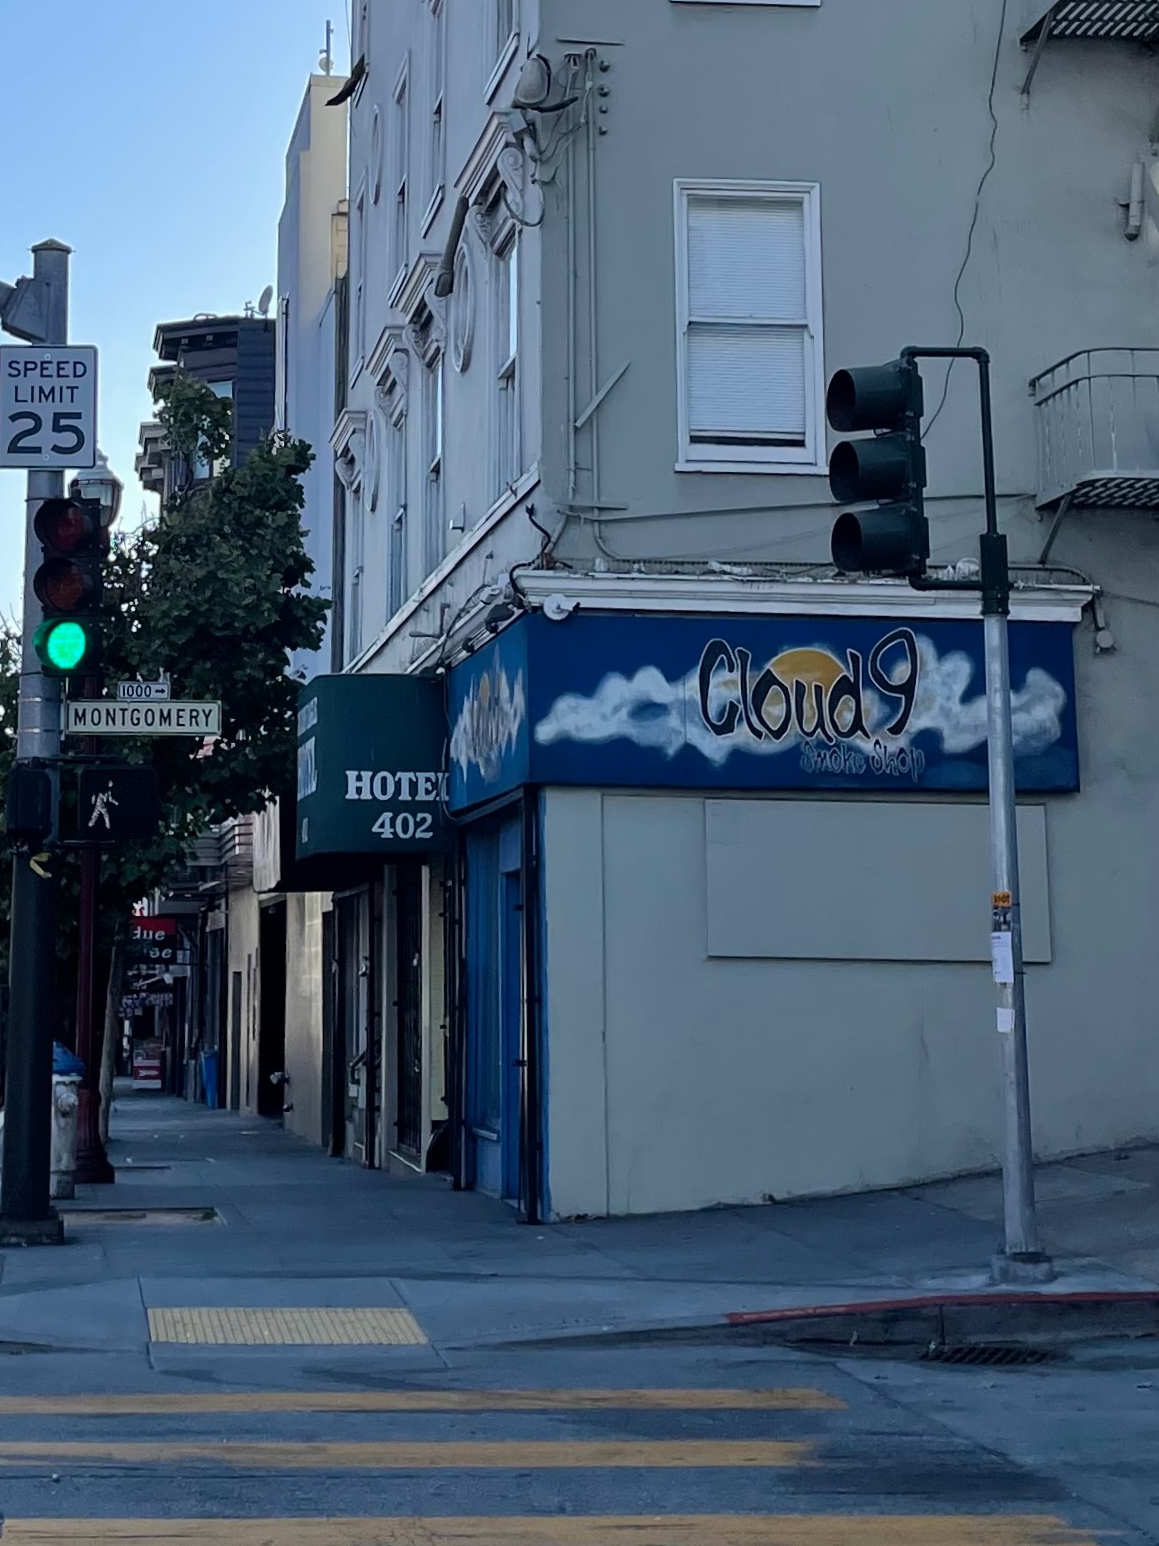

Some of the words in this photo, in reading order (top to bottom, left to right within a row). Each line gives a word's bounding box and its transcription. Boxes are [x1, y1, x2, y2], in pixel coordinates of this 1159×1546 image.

[7, 360, 87, 378] SPEED
[14, 385, 80, 403] LIMIT
[7, 411, 85, 455] 25
[121, 685, 152, 698] 1000
[73, 708, 213, 727] MONTGOMERY
[799, 739, 867, 774] Smoke
[869, 738, 926, 783] Shop
[371, 812, 434, 839] 402
